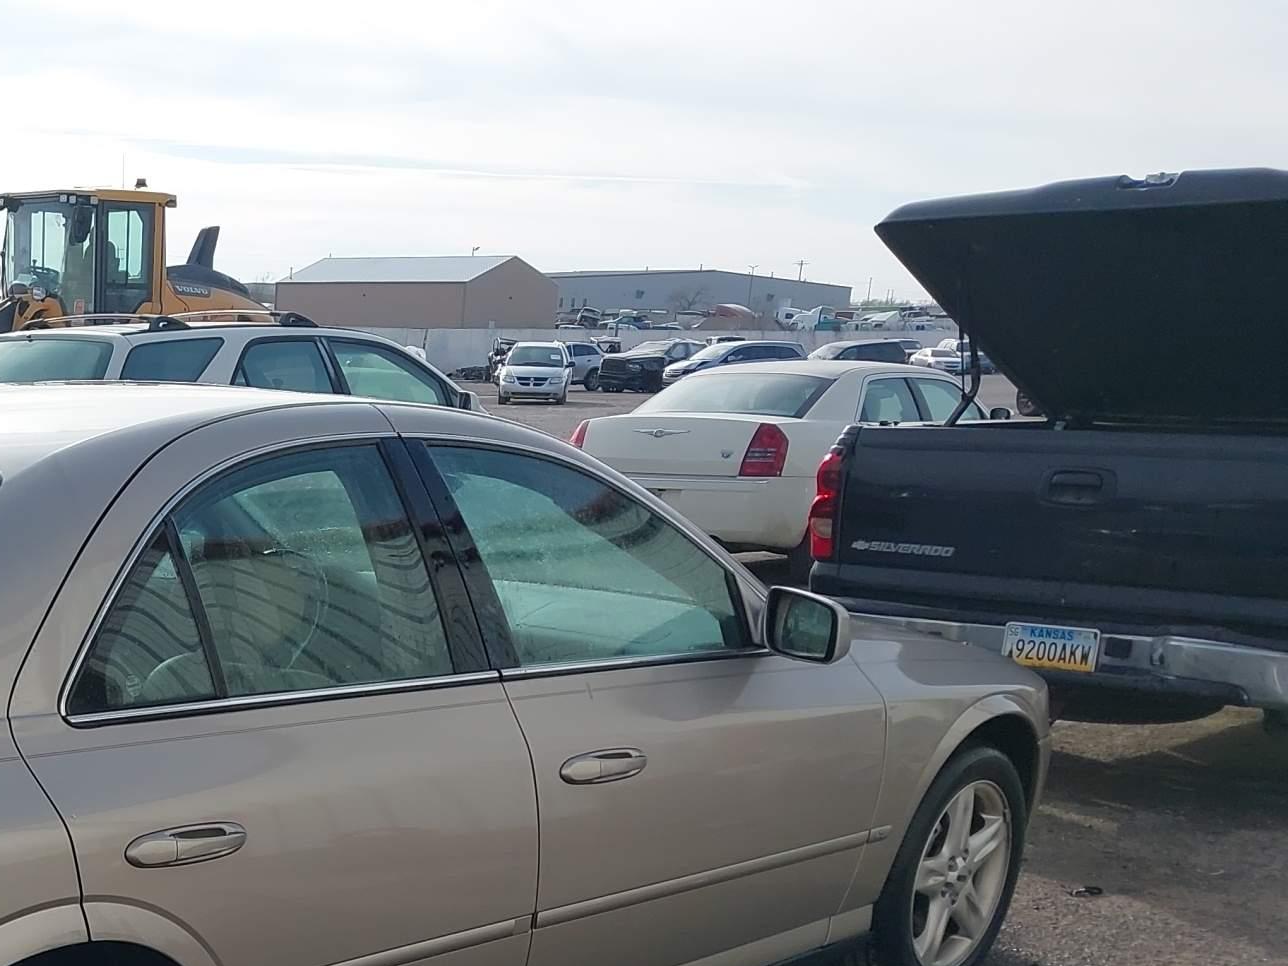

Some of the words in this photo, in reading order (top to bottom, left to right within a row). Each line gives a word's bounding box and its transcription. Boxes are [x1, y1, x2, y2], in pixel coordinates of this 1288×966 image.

[175, 285, 208, 295] VOLVO
[869, 541, 955, 557] SILVERADO
[1030, 627, 1074, 640] KANSAS
[1015, 638, 1091, 666] 9200AKW
